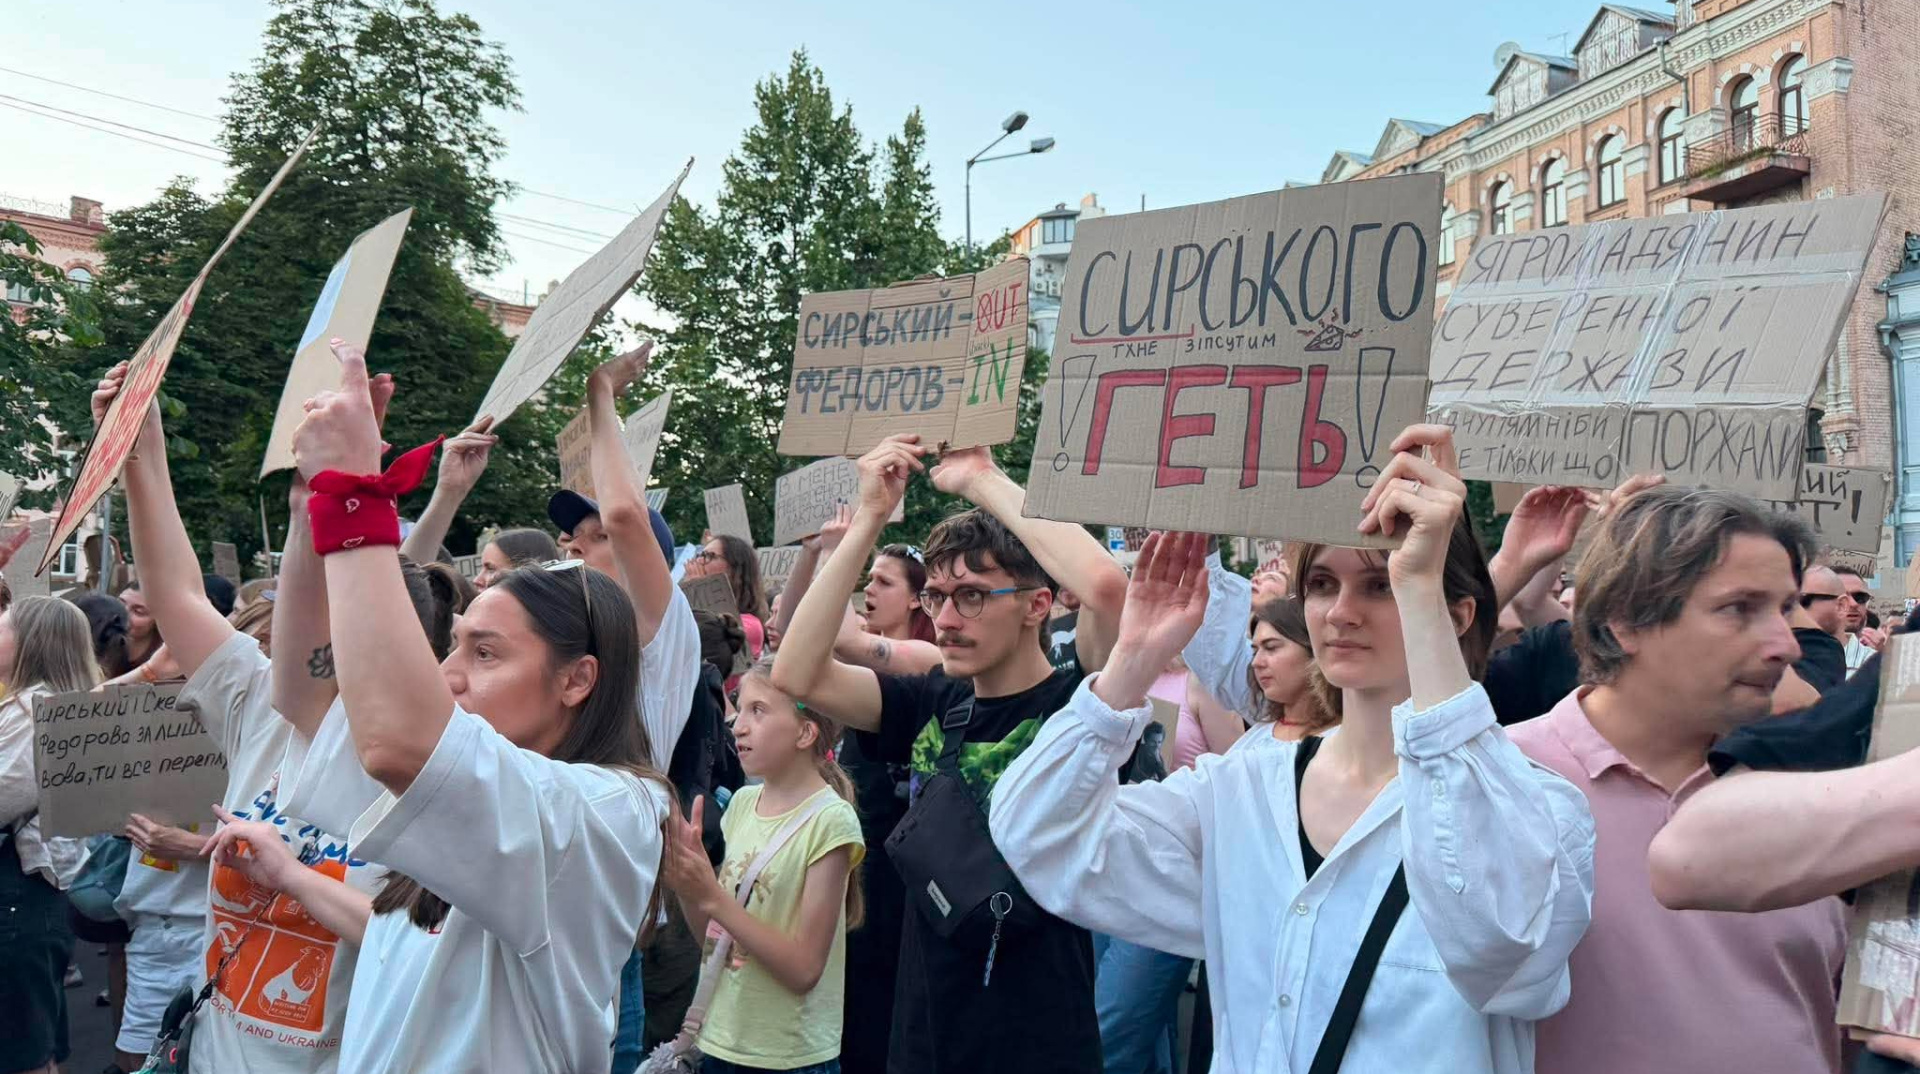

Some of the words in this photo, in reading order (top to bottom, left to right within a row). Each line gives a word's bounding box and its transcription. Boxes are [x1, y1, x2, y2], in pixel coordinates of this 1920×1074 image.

[1079, 221, 1427, 337] СИРСЬКОГО
[974, 281, 1022, 335] OUT
[1441, 286, 1761, 343] СУВЕРЕННОЇ
[1113, 340, 1158, 359] ТХНЕ
[1185, 333, 1276, 354] ЗІПСУТИМ
[966, 336, 1013, 406] IN
[1431, 346, 1748, 398] ДЕРЖАВИ
[1563, 452, 1616, 481] ЩО
[1620, 408, 1800, 483] ПОРЖАЛИ
[799, 460, 850, 486] МЕНЕ
[1801, 468, 1851, 500] ИЙ
[158, 752, 228, 775] перепл
[245, 1023, 274, 1040] AND
[278, 1031, 338, 1049] UKRAINE
